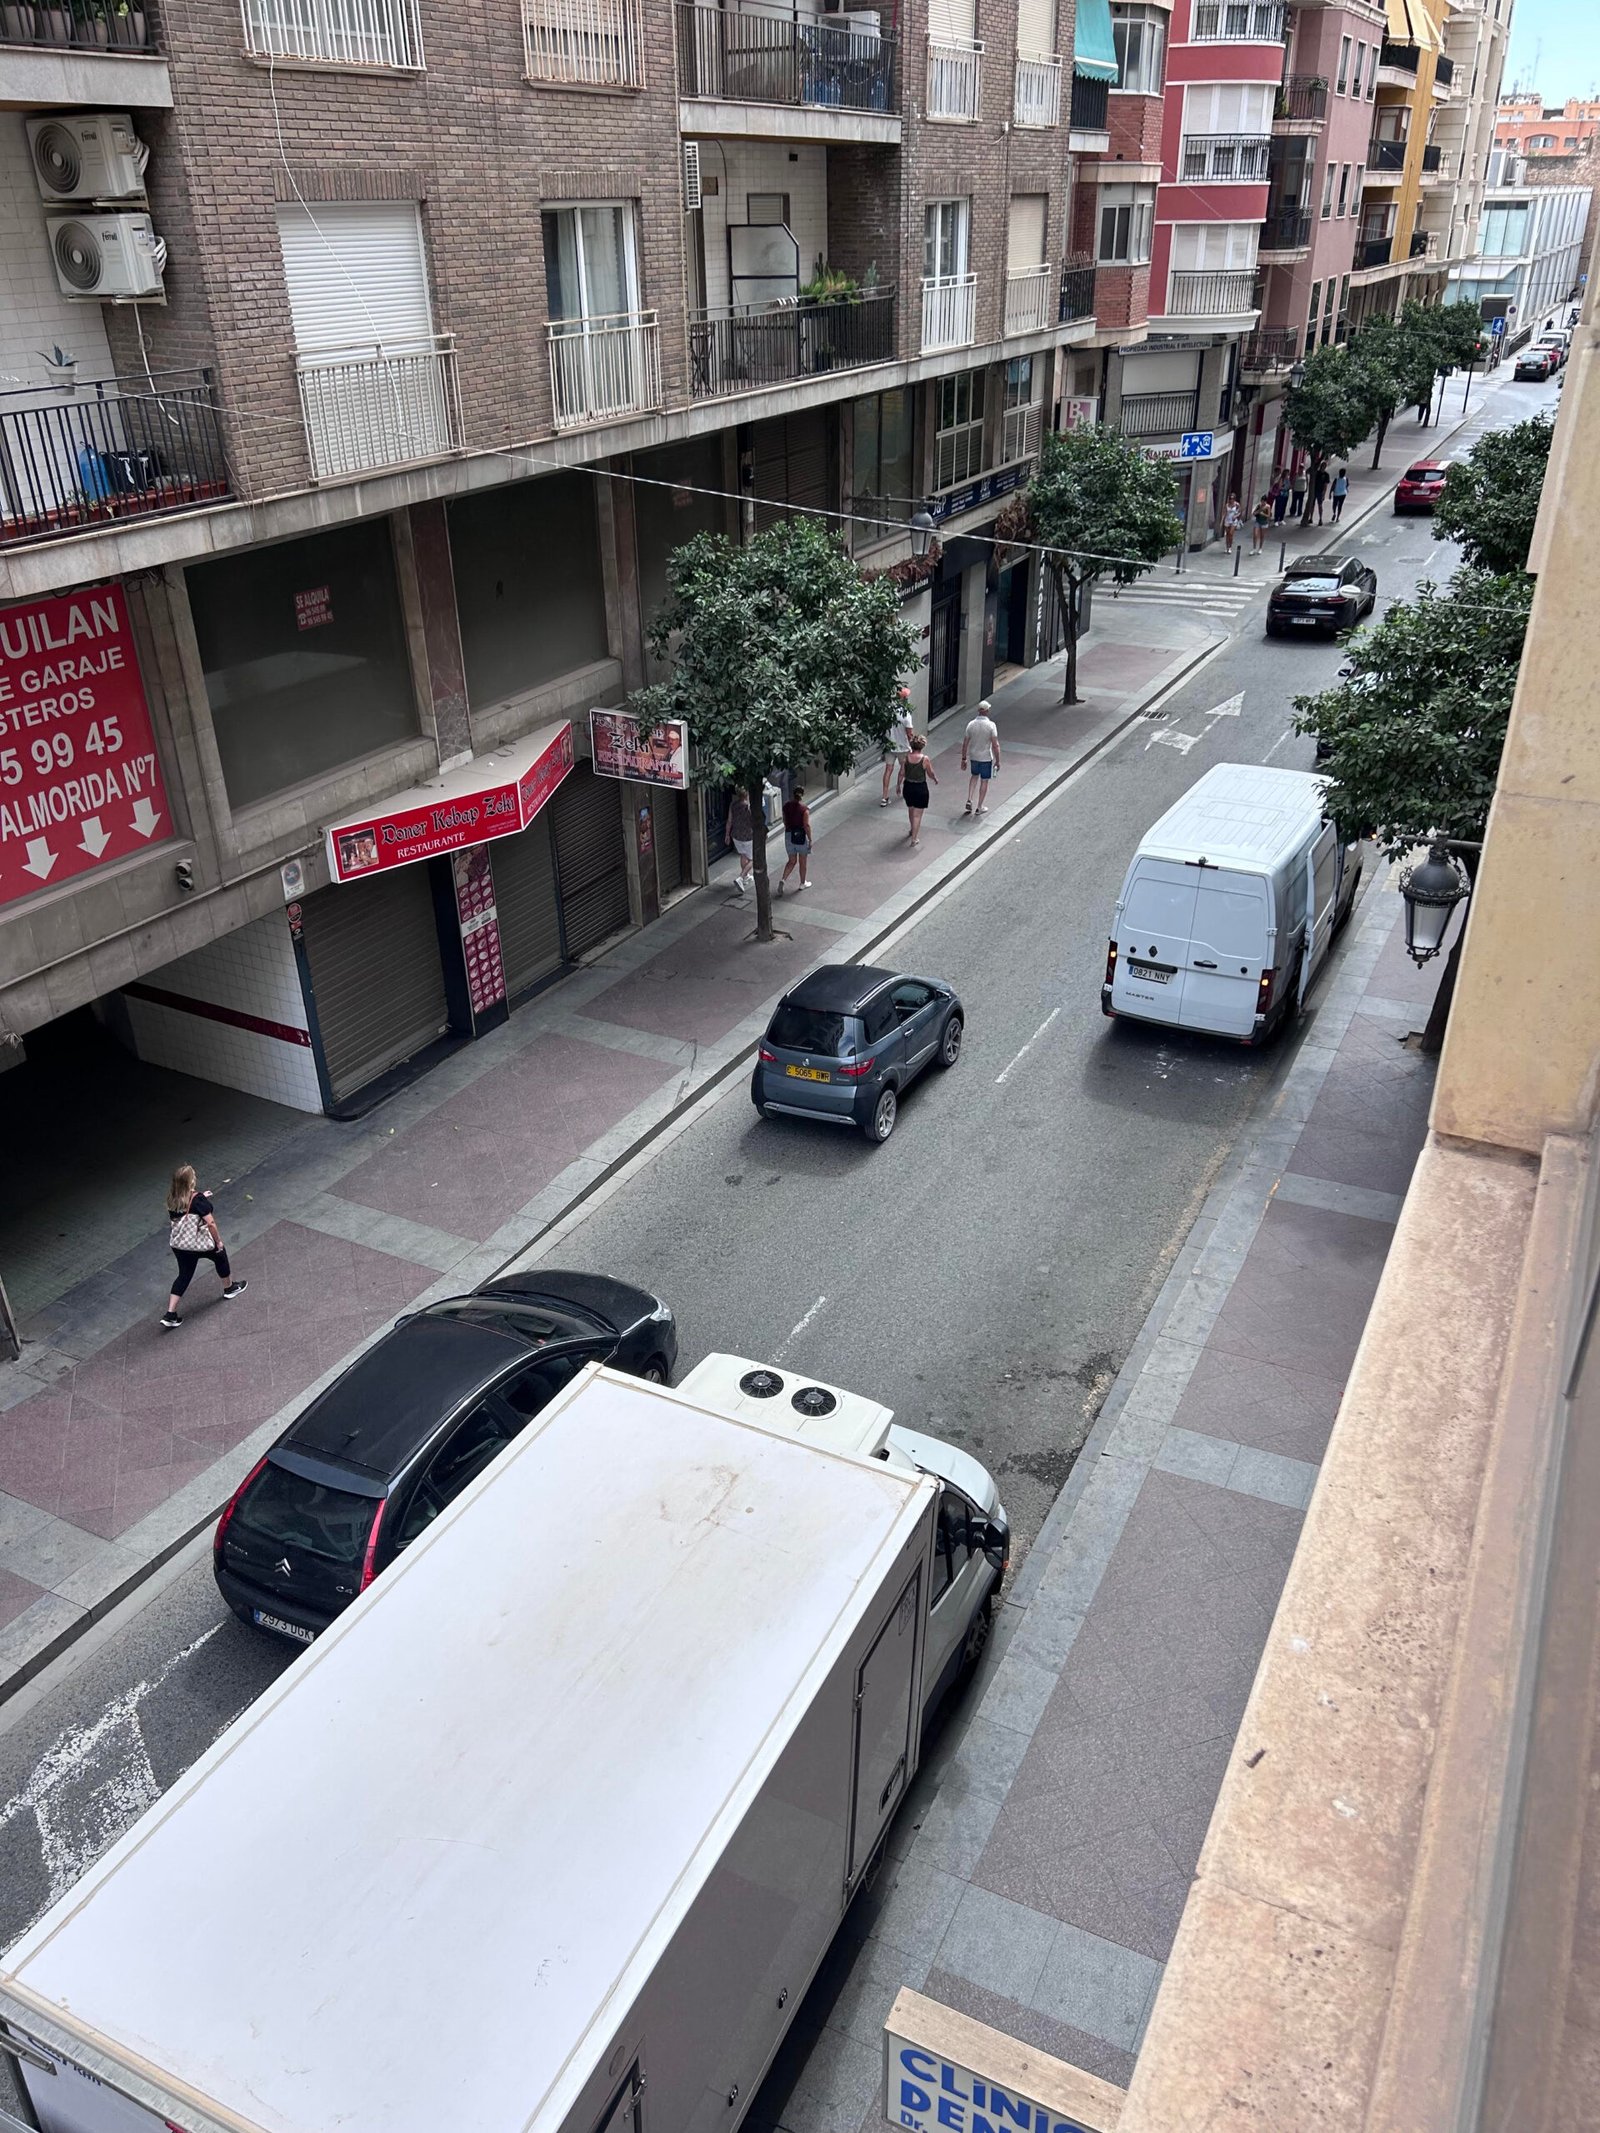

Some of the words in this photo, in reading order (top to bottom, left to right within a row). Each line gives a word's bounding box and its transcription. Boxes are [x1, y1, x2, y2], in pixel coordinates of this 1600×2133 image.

[1121, 345, 1148, 353] PROPIEDAD
[1148, 343, 1175, 351] INDUSTRIAL
[295, 595, 304, 609] SE
[304, 588, 330, 607] ALQUILA
[0, 597, 120, 666] UILAN
[0, 676, 15, 702] E
[20, 646, 126, 693] GARAJE
[0, 686, 96, 736] STEROS
[0, 747, 23, 785] 5
[31, 732, 74, 775] 99
[85, 716, 123, 756] 45
[607, 732, 650, 753] Zeki
[382, 821, 427, 845] Doner
[432, 805, 480, 833] Kebap
[482, 791, 516, 818] Zeki
[397, 831, 466, 859] RESTAURANTE
[1133, 967, 1153, 978] 0821
[1154, 972, 1172, 982] NNY
[1125, 991, 1155, 1001] MASTER
[795, 1067, 813, 1078] 5065
[815, 1070, 830, 1081] BWR
[901, 2079, 1012, 2133] DEN
